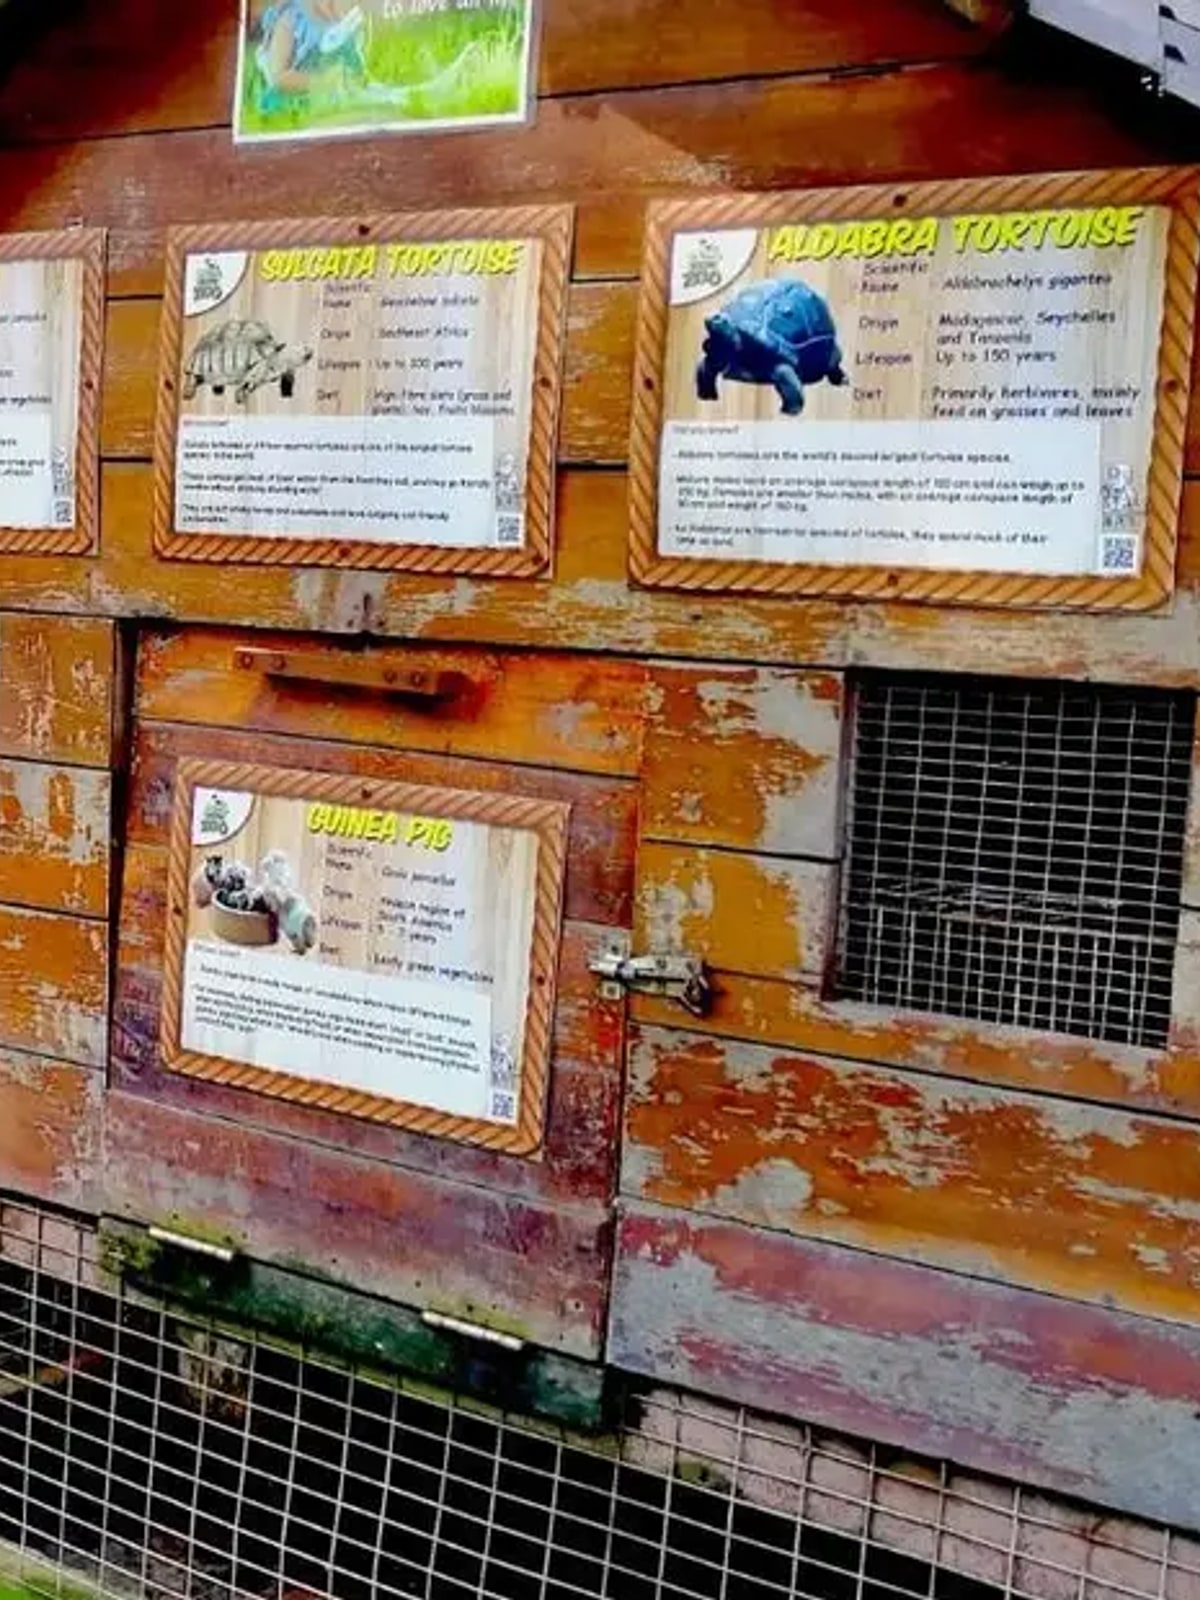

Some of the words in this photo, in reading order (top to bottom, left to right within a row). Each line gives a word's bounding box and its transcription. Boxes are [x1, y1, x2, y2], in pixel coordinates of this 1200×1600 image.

[770, 215, 938, 261] ALDABRA
[954, 205, 1145, 254] TORTOISE
[260, 245, 377, 282] SULCATA
[387, 238, 525, 278] TORTOISE
[858, 315, 900, 331] Origin
[1036, 309, 1117, 328] Seychelles
[936, 333, 962, 345] and
[855, 352, 913, 367] Lifespan
[936, 350, 955, 367] Up
[961, 350, 977, 362] to
[983, 349, 1011, 363] 150
[1016, 350, 1057, 365] years
[931, 386, 995, 402] Primarily
[932, 403, 967, 418] feed
[970, 405, 987, 417] on
[990, 405, 1045, 420] grasses
[1051, 404, 1082, 418] and
[1085, 403, 1133, 418] leaves
[307, 804, 397, 844] GUINEA
[405, 815, 453, 852] PIG
